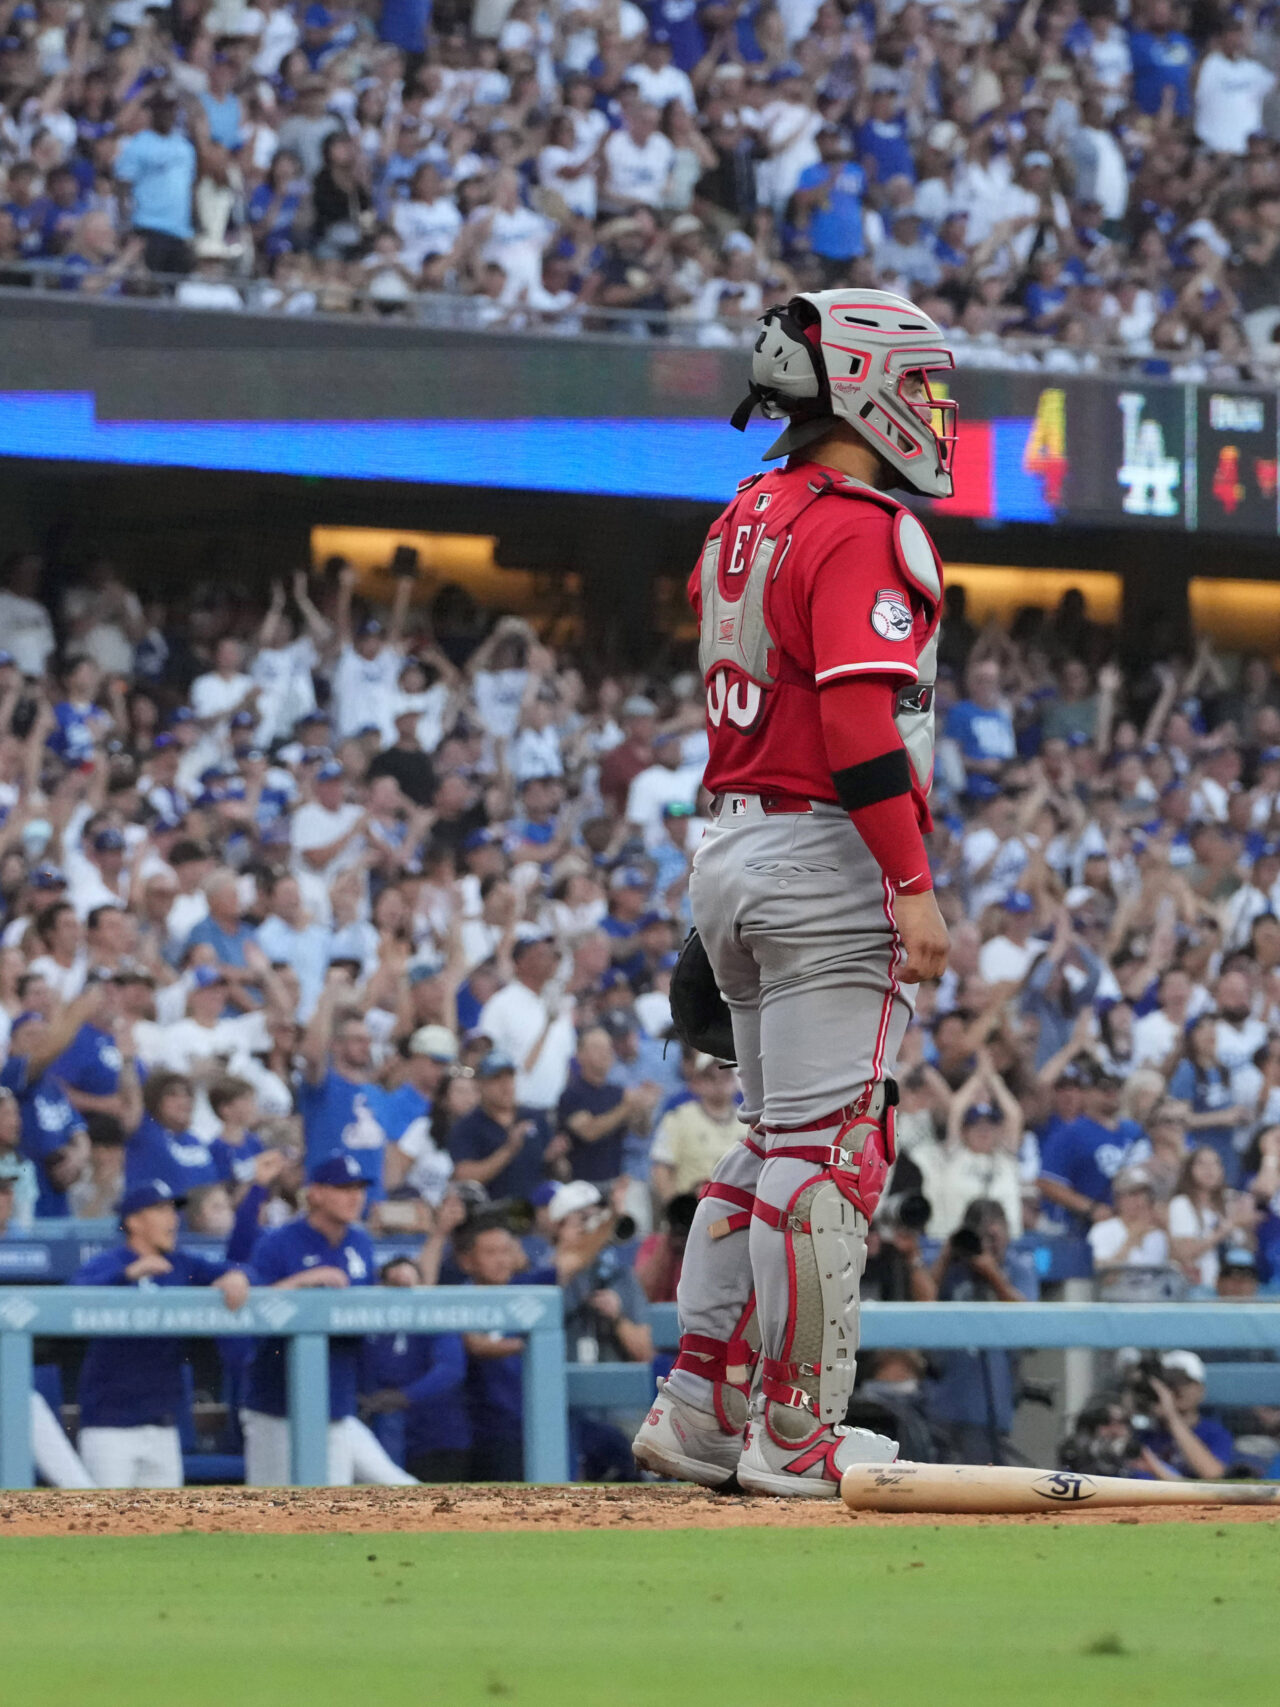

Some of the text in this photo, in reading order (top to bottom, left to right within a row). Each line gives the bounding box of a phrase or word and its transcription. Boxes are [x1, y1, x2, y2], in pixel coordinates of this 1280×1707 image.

[1118, 392, 1180, 516] LA
[72, 1308, 129, 1330] BANK
[330, 1305, 506, 1328] BANK OF AMERICA
